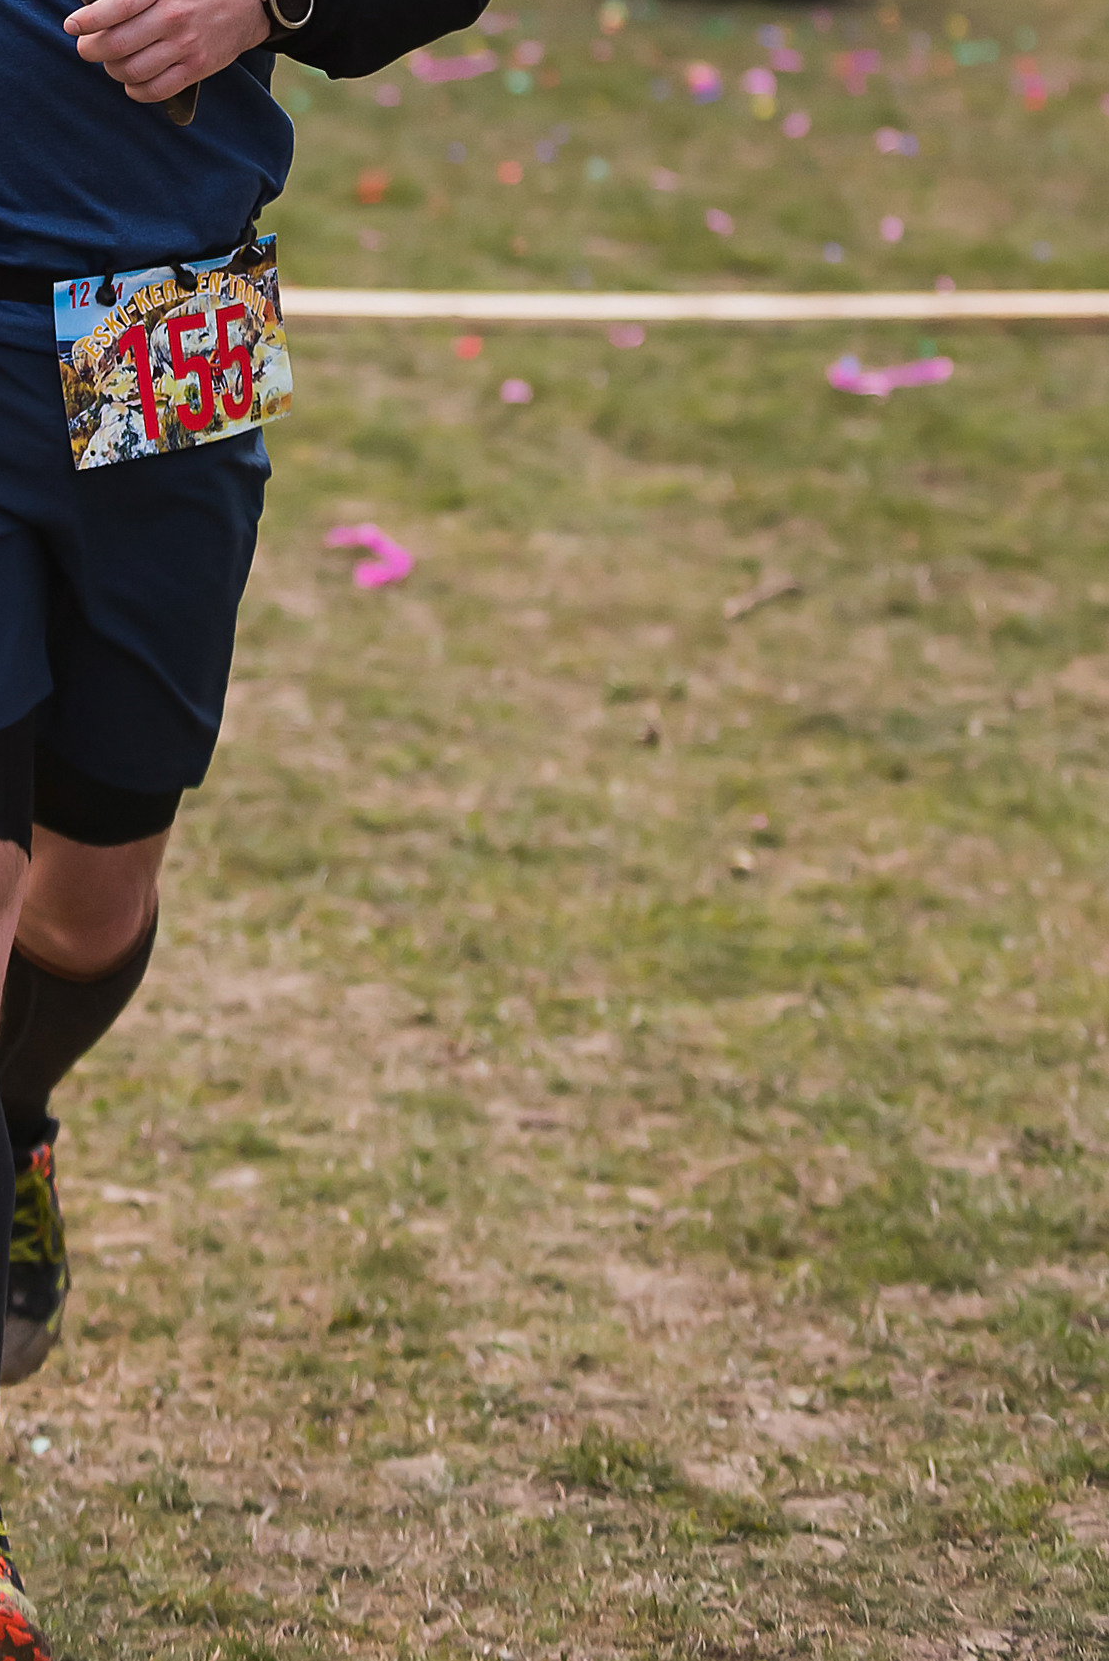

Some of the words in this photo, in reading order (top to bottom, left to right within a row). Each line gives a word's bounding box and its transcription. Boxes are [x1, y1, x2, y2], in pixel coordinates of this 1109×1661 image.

[69, 281, 90, 309] 12
[228, 273, 267, 322] TRAIL
[118, 303, 253, 440] 155
